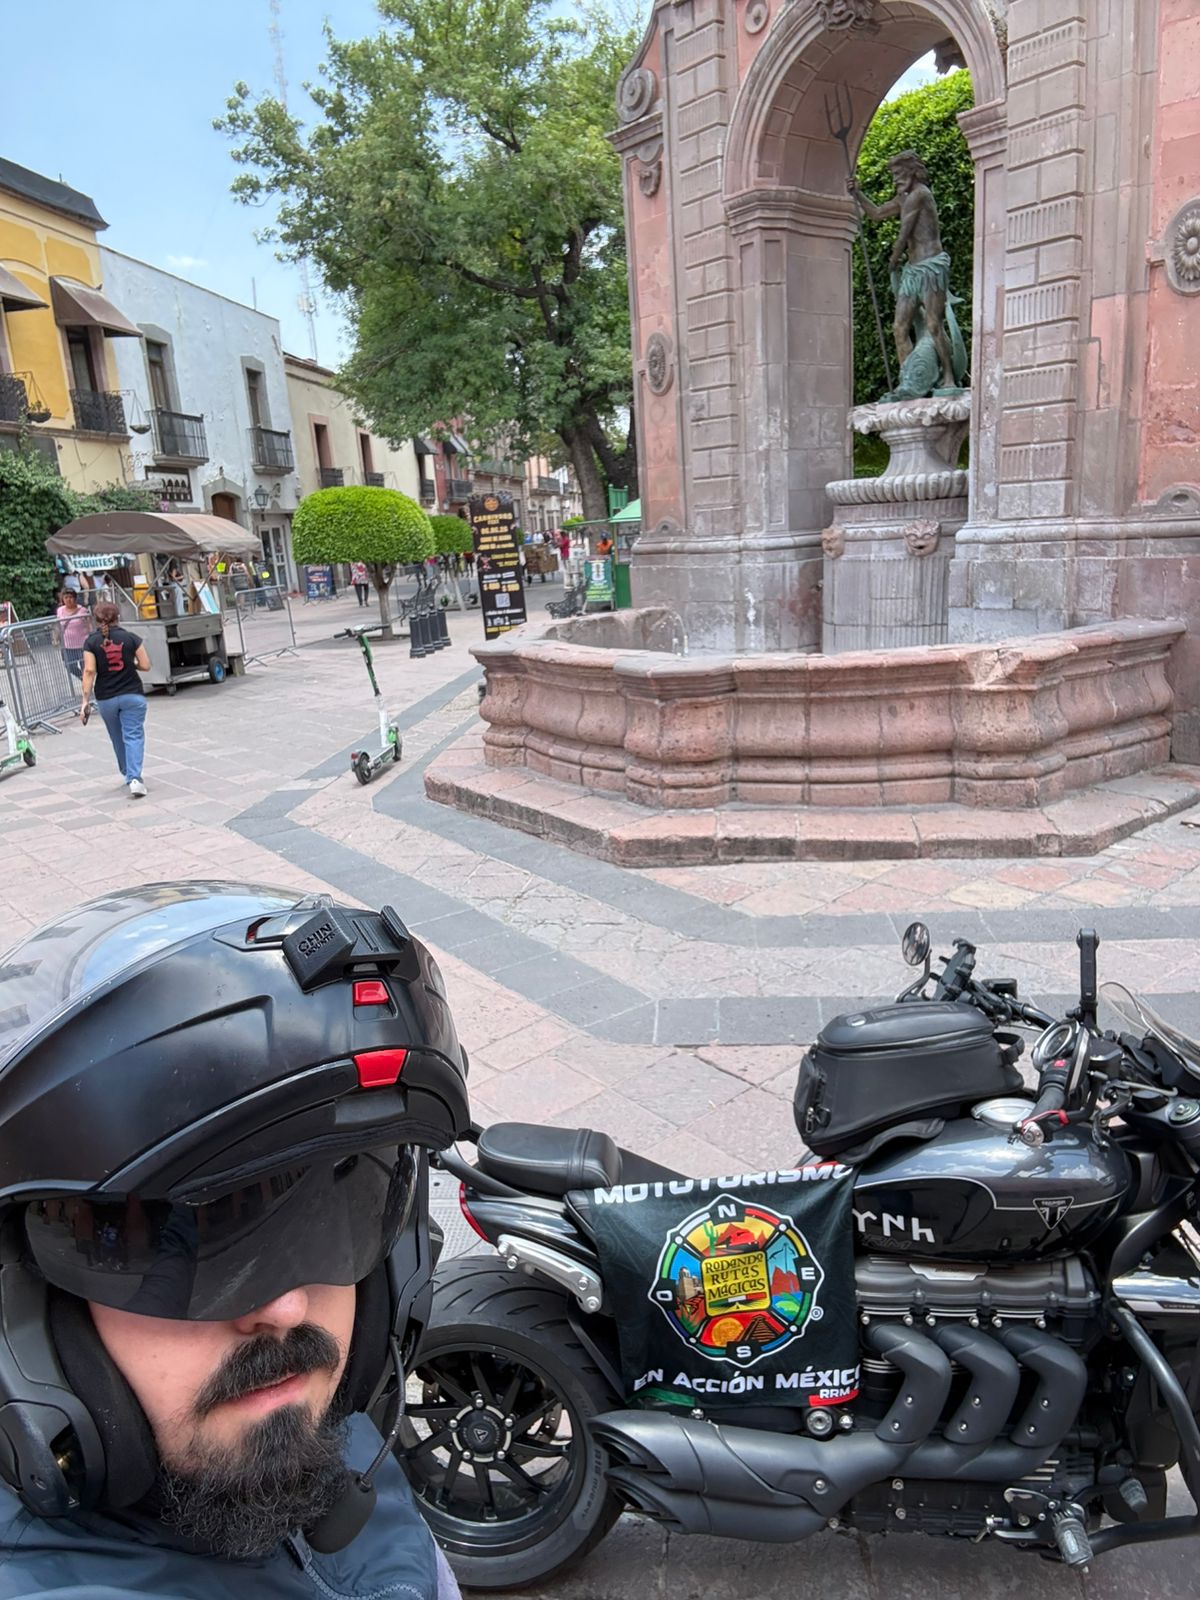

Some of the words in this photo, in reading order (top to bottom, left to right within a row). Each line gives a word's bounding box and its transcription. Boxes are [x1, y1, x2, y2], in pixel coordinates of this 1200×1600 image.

[298, 922, 332, 952] CHIN
[718, 1204, 736, 1218] N
[801, 1267, 815, 1280] E
[736, 1345, 752, 1358] S
[633, 1369, 664, 1391] EN
[672, 1370, 764, 1394] ACCIÓN
[819, 1388, 850, 1400] RRM
